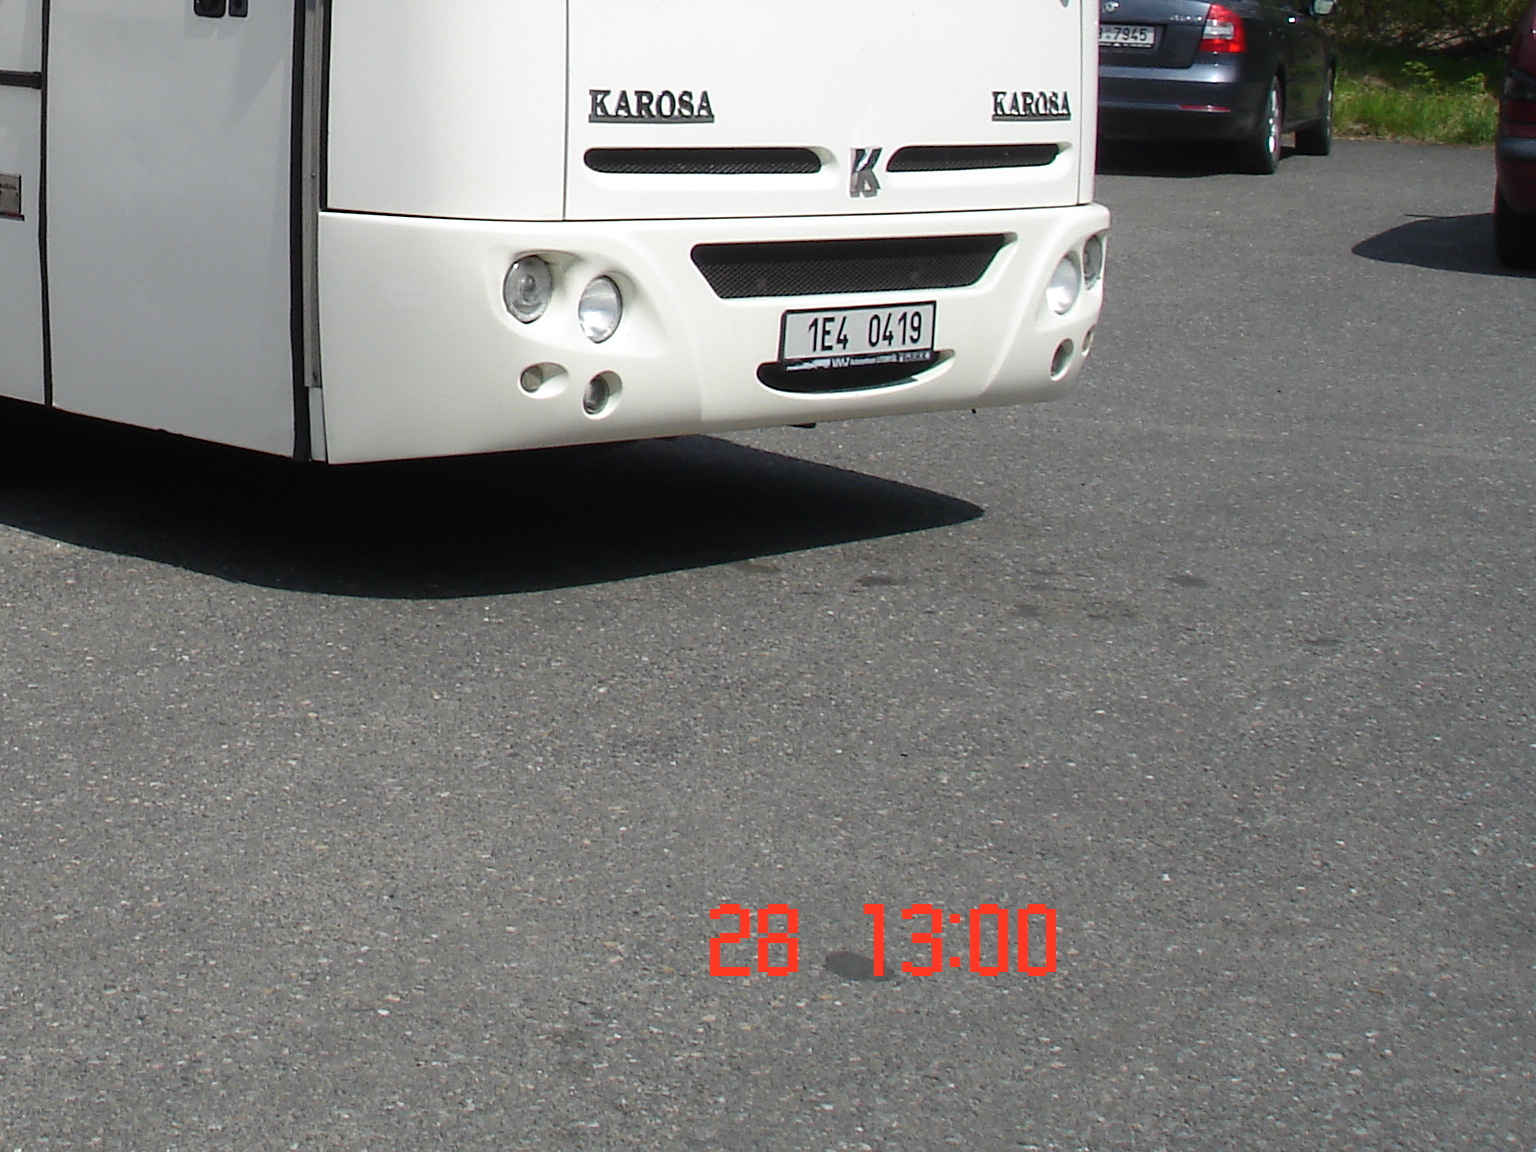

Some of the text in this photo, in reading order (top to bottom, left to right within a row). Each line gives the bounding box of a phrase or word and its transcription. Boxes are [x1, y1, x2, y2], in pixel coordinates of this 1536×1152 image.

[1113, 28, 1147, 42] 7945
[589, 89, 714, 120] KAROSA
[991, 91, 1071, 119] KAROSA
[808, 311, 922, 353] 1E4 0419
